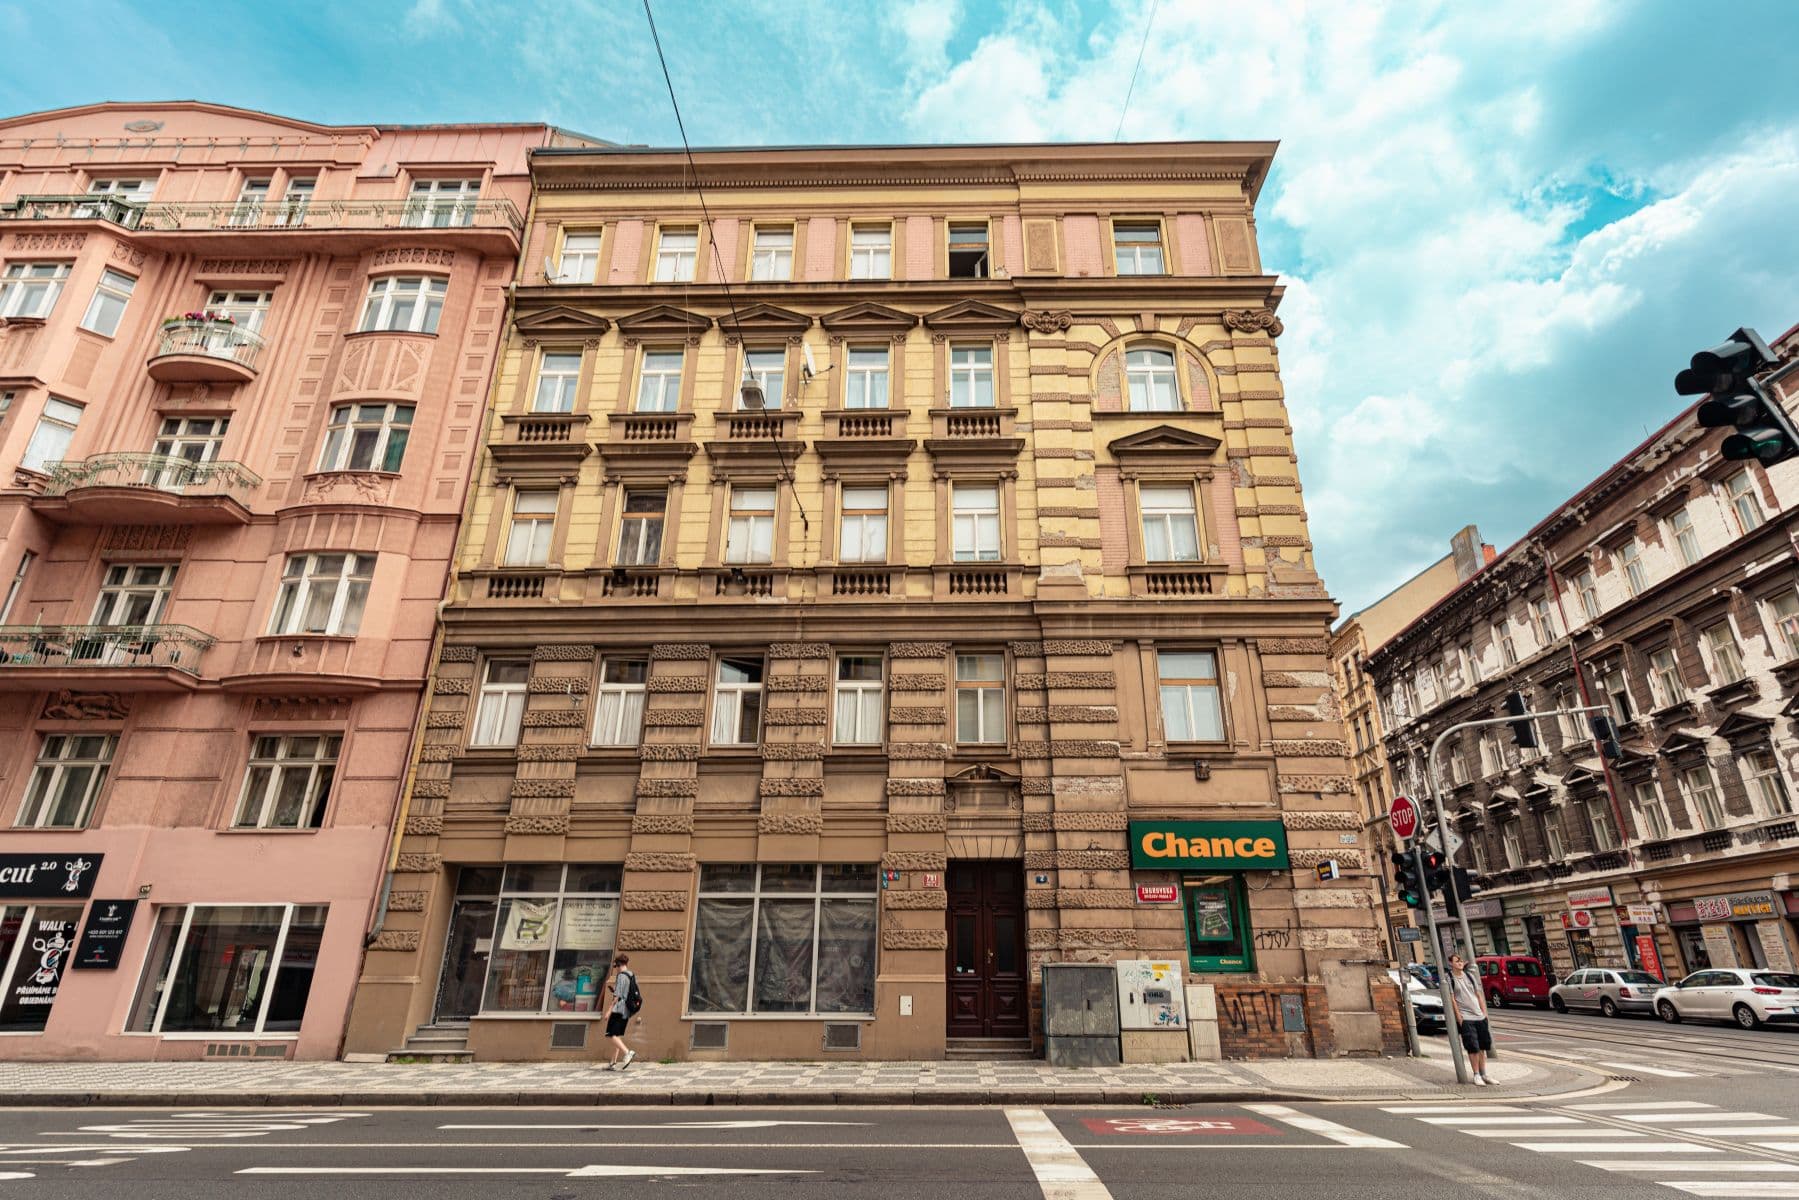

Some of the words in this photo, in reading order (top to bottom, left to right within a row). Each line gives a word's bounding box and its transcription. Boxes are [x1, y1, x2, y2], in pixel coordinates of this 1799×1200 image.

[1392, 807, 1412, 827] STOP
[1142, 832, 1276, 858] Chance
[40, 861, 58, 870] 2.0
[39, 921, 66, 931] WALK
